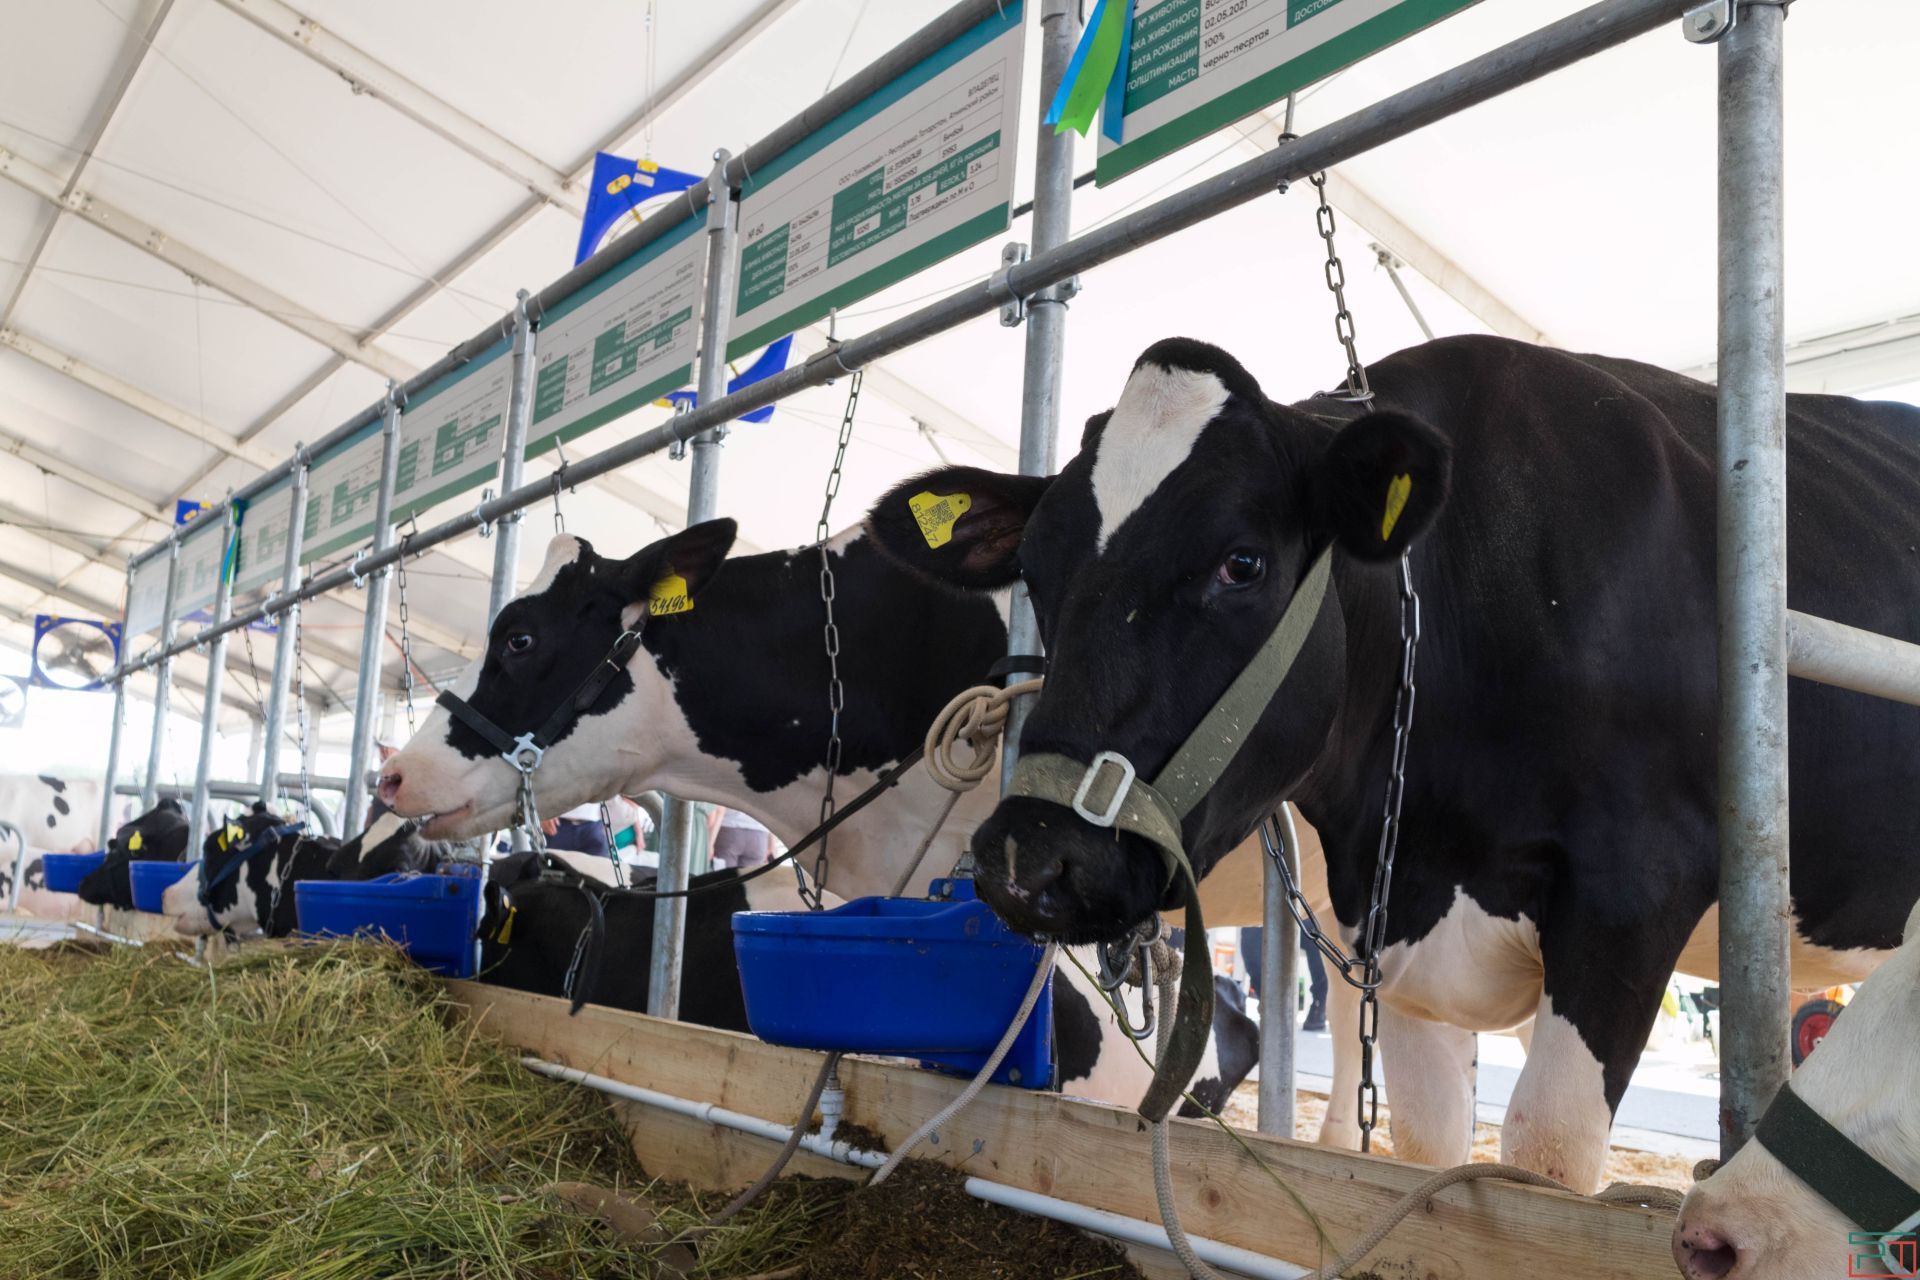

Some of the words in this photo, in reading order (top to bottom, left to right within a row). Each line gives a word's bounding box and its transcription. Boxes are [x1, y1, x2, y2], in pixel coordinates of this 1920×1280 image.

[1148, 7, 1199, 43] ЖИВОТНОГО
[1204, 32, 1225, 49] 100%
[1131, 52, 1152, 73] ДАТА
[1153, 26, 1198, 58] РОЖДЕНИЯ
[1127, 46, 1198, 91] ГОЛШТИНИЗАЦИИ
[1169, 67, 1197, 89] МАСТЬ
[910, 196, 948, 221] Подтверждено
[911, 504, 939, 543] 81247
